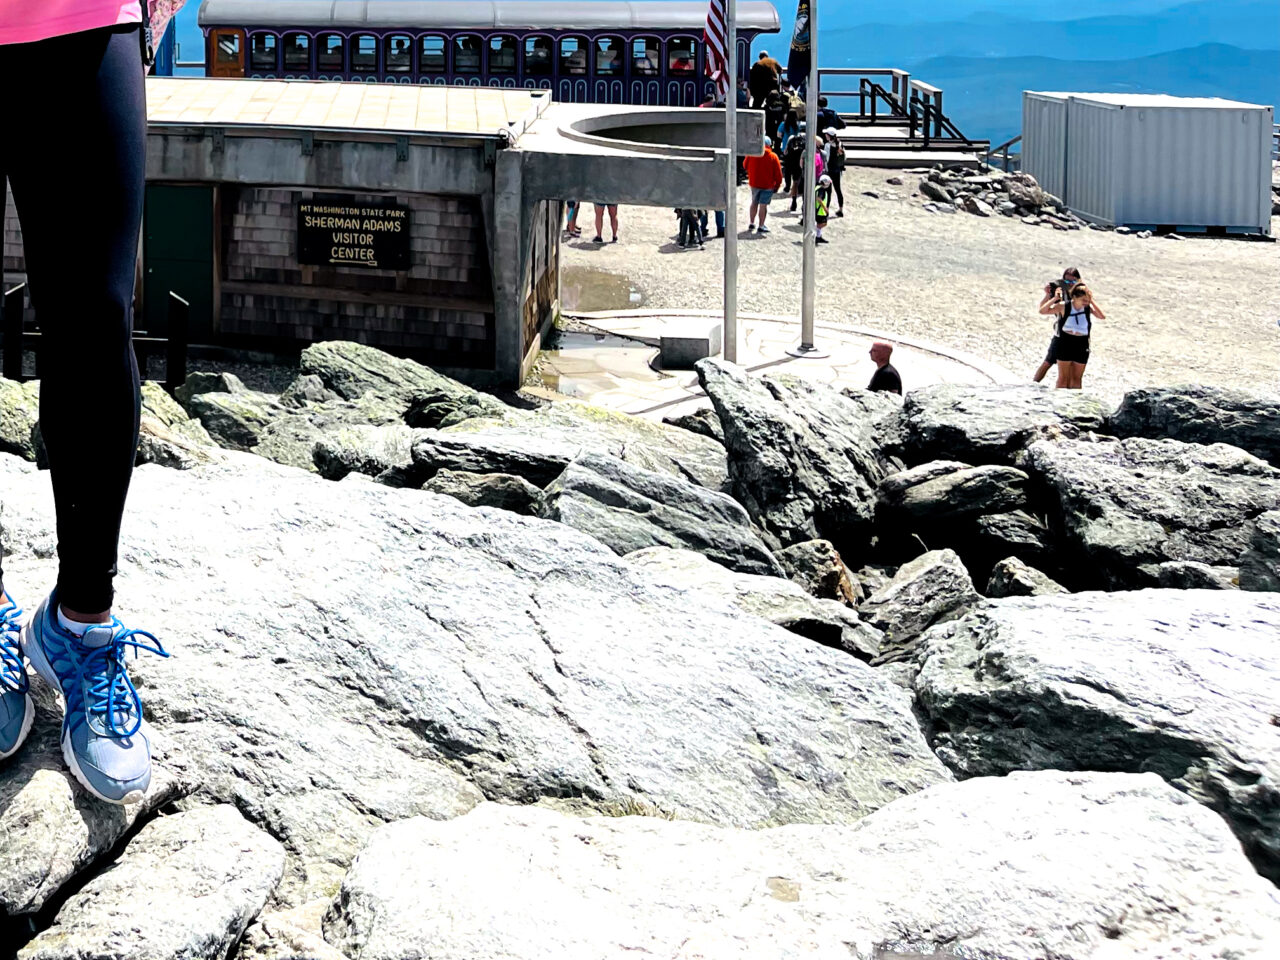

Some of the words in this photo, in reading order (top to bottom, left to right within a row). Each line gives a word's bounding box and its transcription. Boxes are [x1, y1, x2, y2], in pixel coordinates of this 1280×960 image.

[300, 205, 312, 213] MT
[313, 206, 360, 215] WASHINGTON
[361, 208, 384, 217] STATE
[385, 209, 406, 218] PARK
[305, 215, 360, 230] SHERMAN
[362, 219, 401, 232] ADAMS
[332, 232, 374, 245] VISITOR
[331, 246, 374, 260] CENTER
